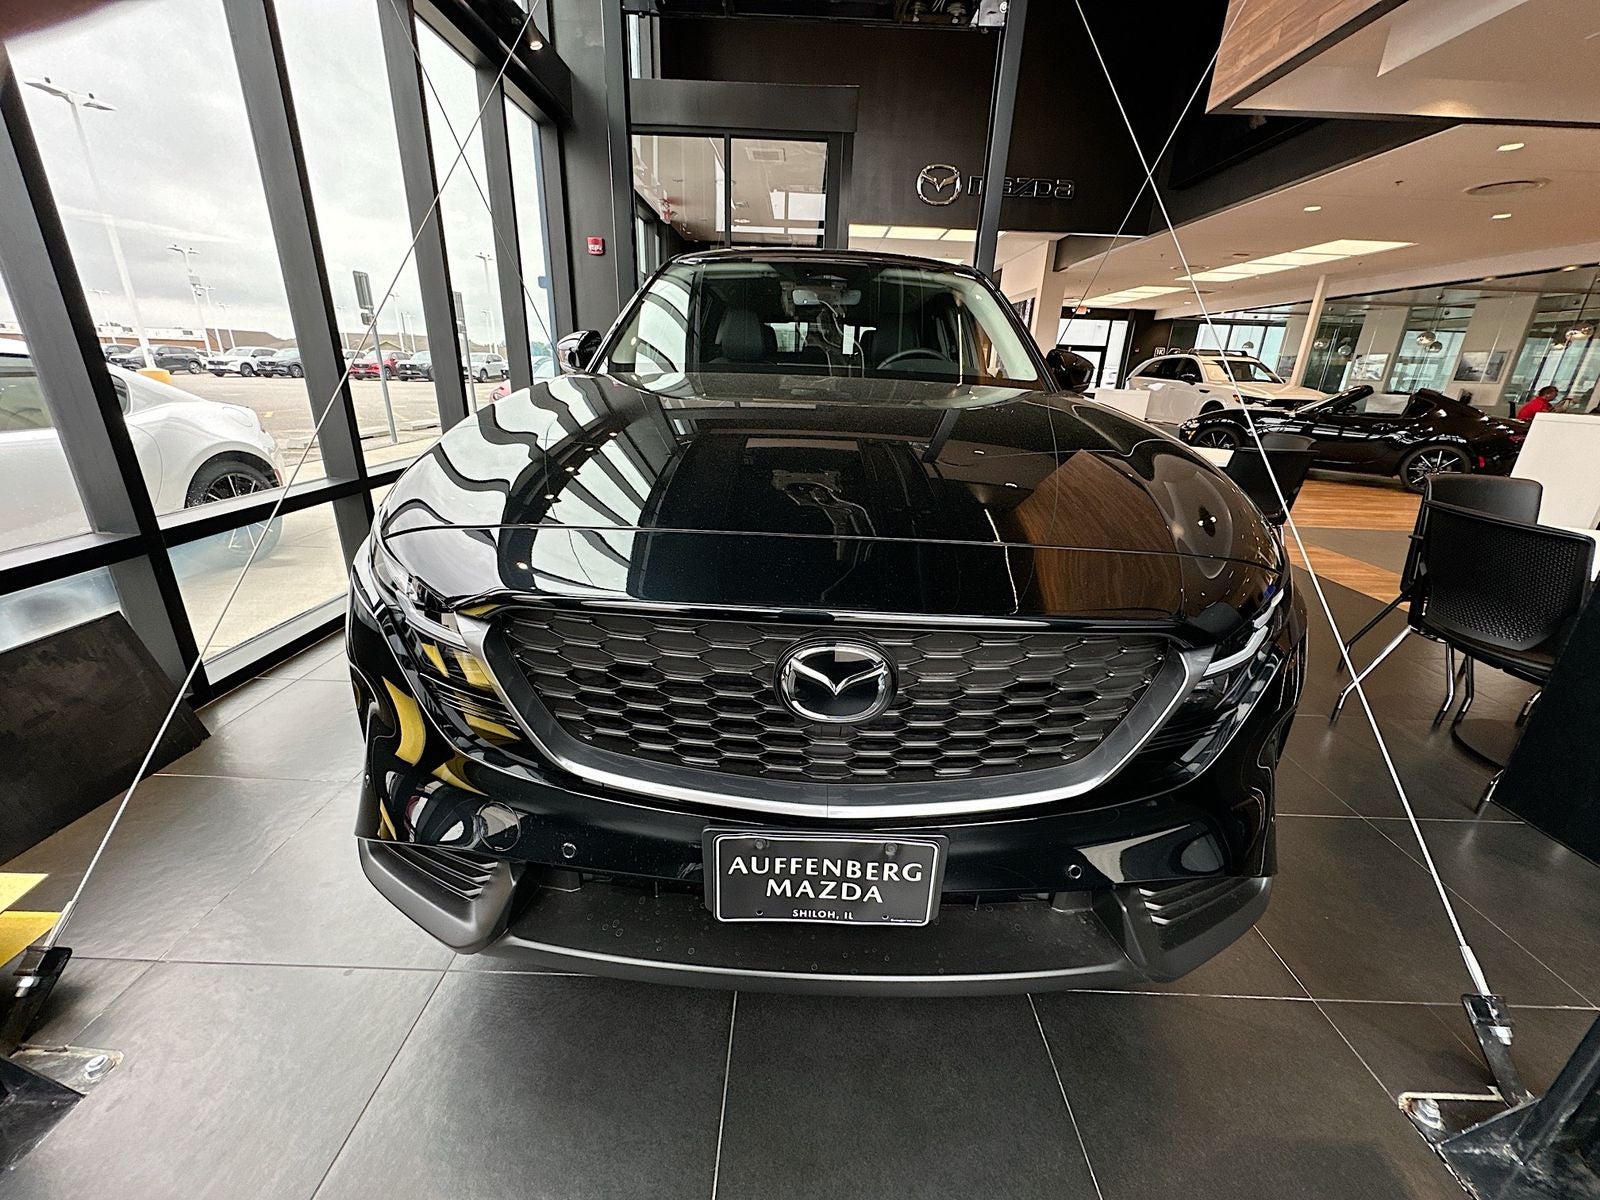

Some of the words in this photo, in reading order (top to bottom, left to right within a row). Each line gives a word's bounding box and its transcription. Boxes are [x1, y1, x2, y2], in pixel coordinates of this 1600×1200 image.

[728, 856, 923, 882] AUFFENBERG
[766, 879, 884, 904] MAZDA
[792, 909, 840, 920] SHILOH,
[843, 911, 854, 920] IL
